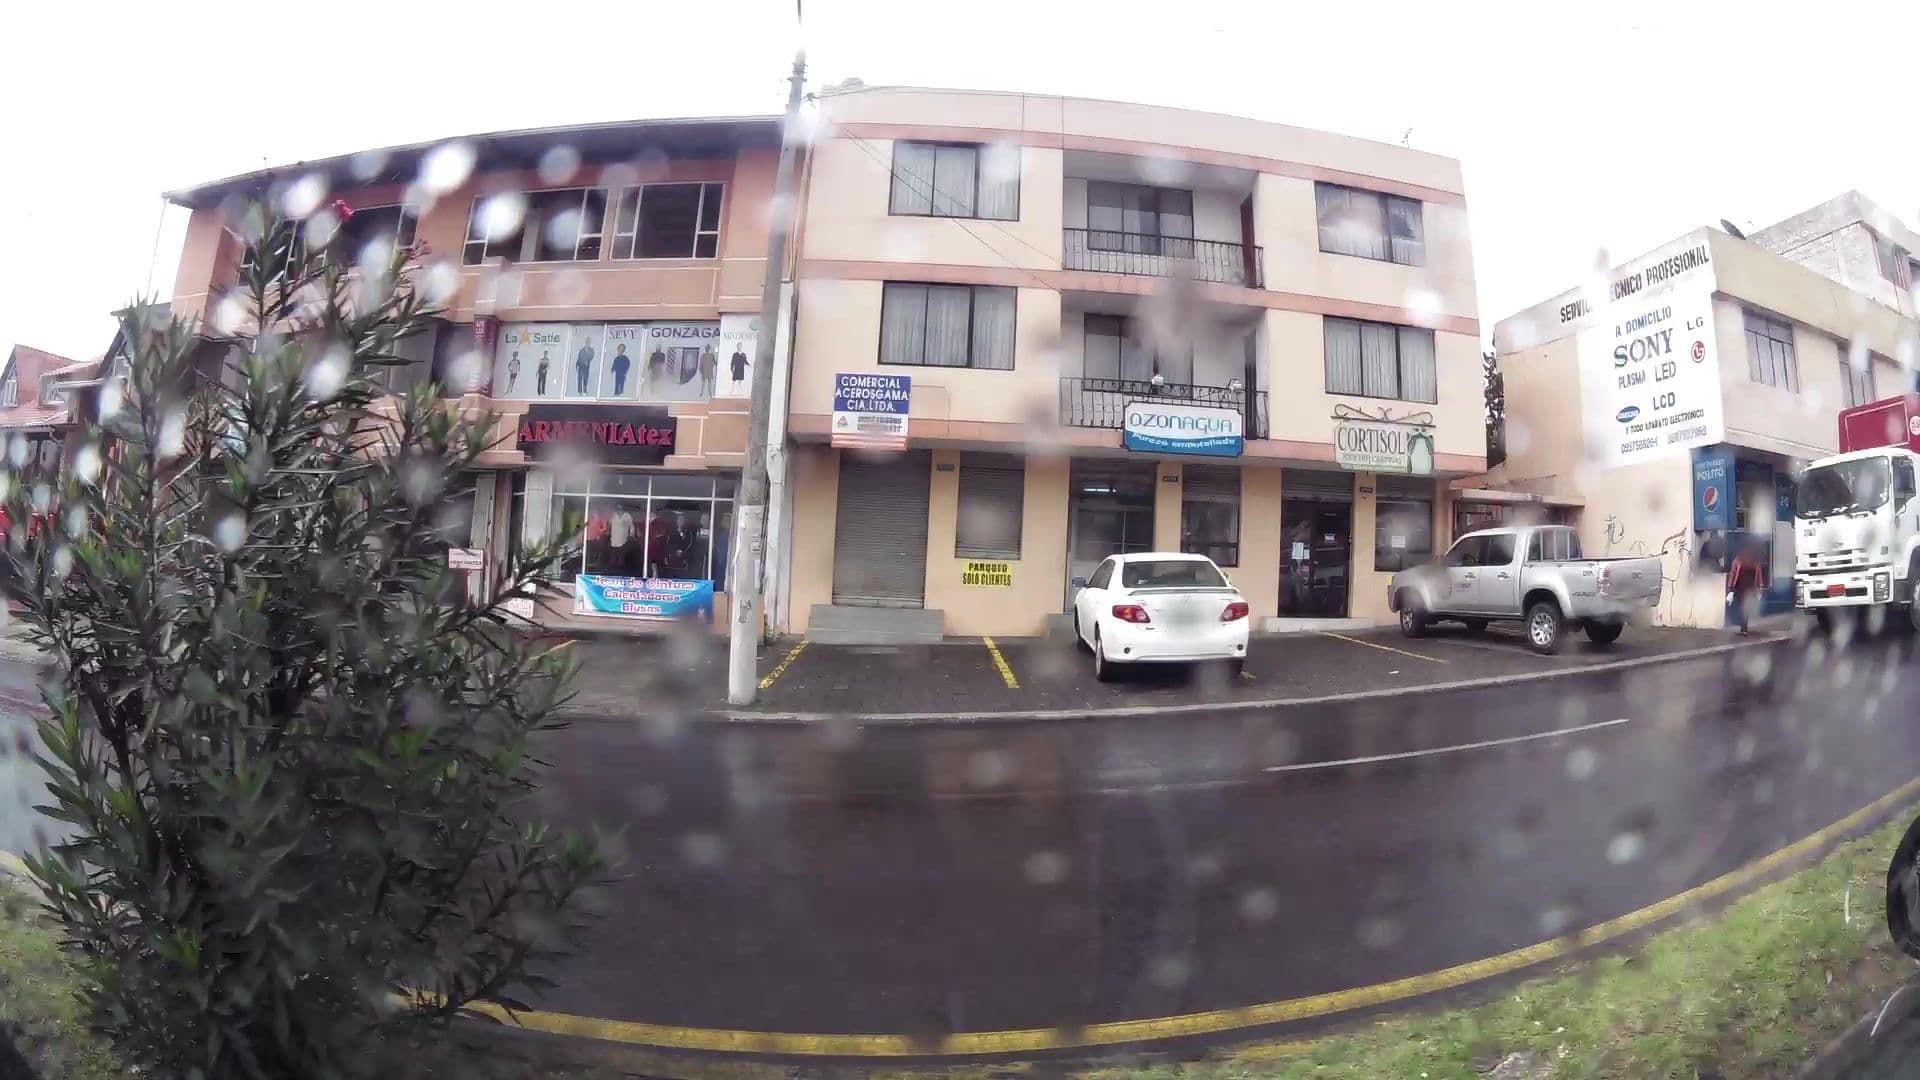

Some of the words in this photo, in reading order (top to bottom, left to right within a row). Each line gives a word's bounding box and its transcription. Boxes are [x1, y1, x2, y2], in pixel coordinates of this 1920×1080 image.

[1646, 244, 1710, 286] PROFESIONAL
[1625, 305, 1672, 335] DOMICILIO
[505, 333, 518, 344] La
[651, 327, 720, 339] GONZAGA
[1613, 327, 1674, 369] SONY
[841, 376, 901, 389] COMERCIAL
[1618, 369, 1646, 390] PLASMA
[1655, 360, 1676, 382] LED
[835, 387, 909, 401] ACEROSGAMA
[1652, 391, 1676, 411] LCD
[1337, 426, 1406, 455] CORTISOL
[968, 562, 1008, 573] PARQUEO
[962, 573, 979, 585] SOLO
[980, 573, 1012, 587] CLIENTES
